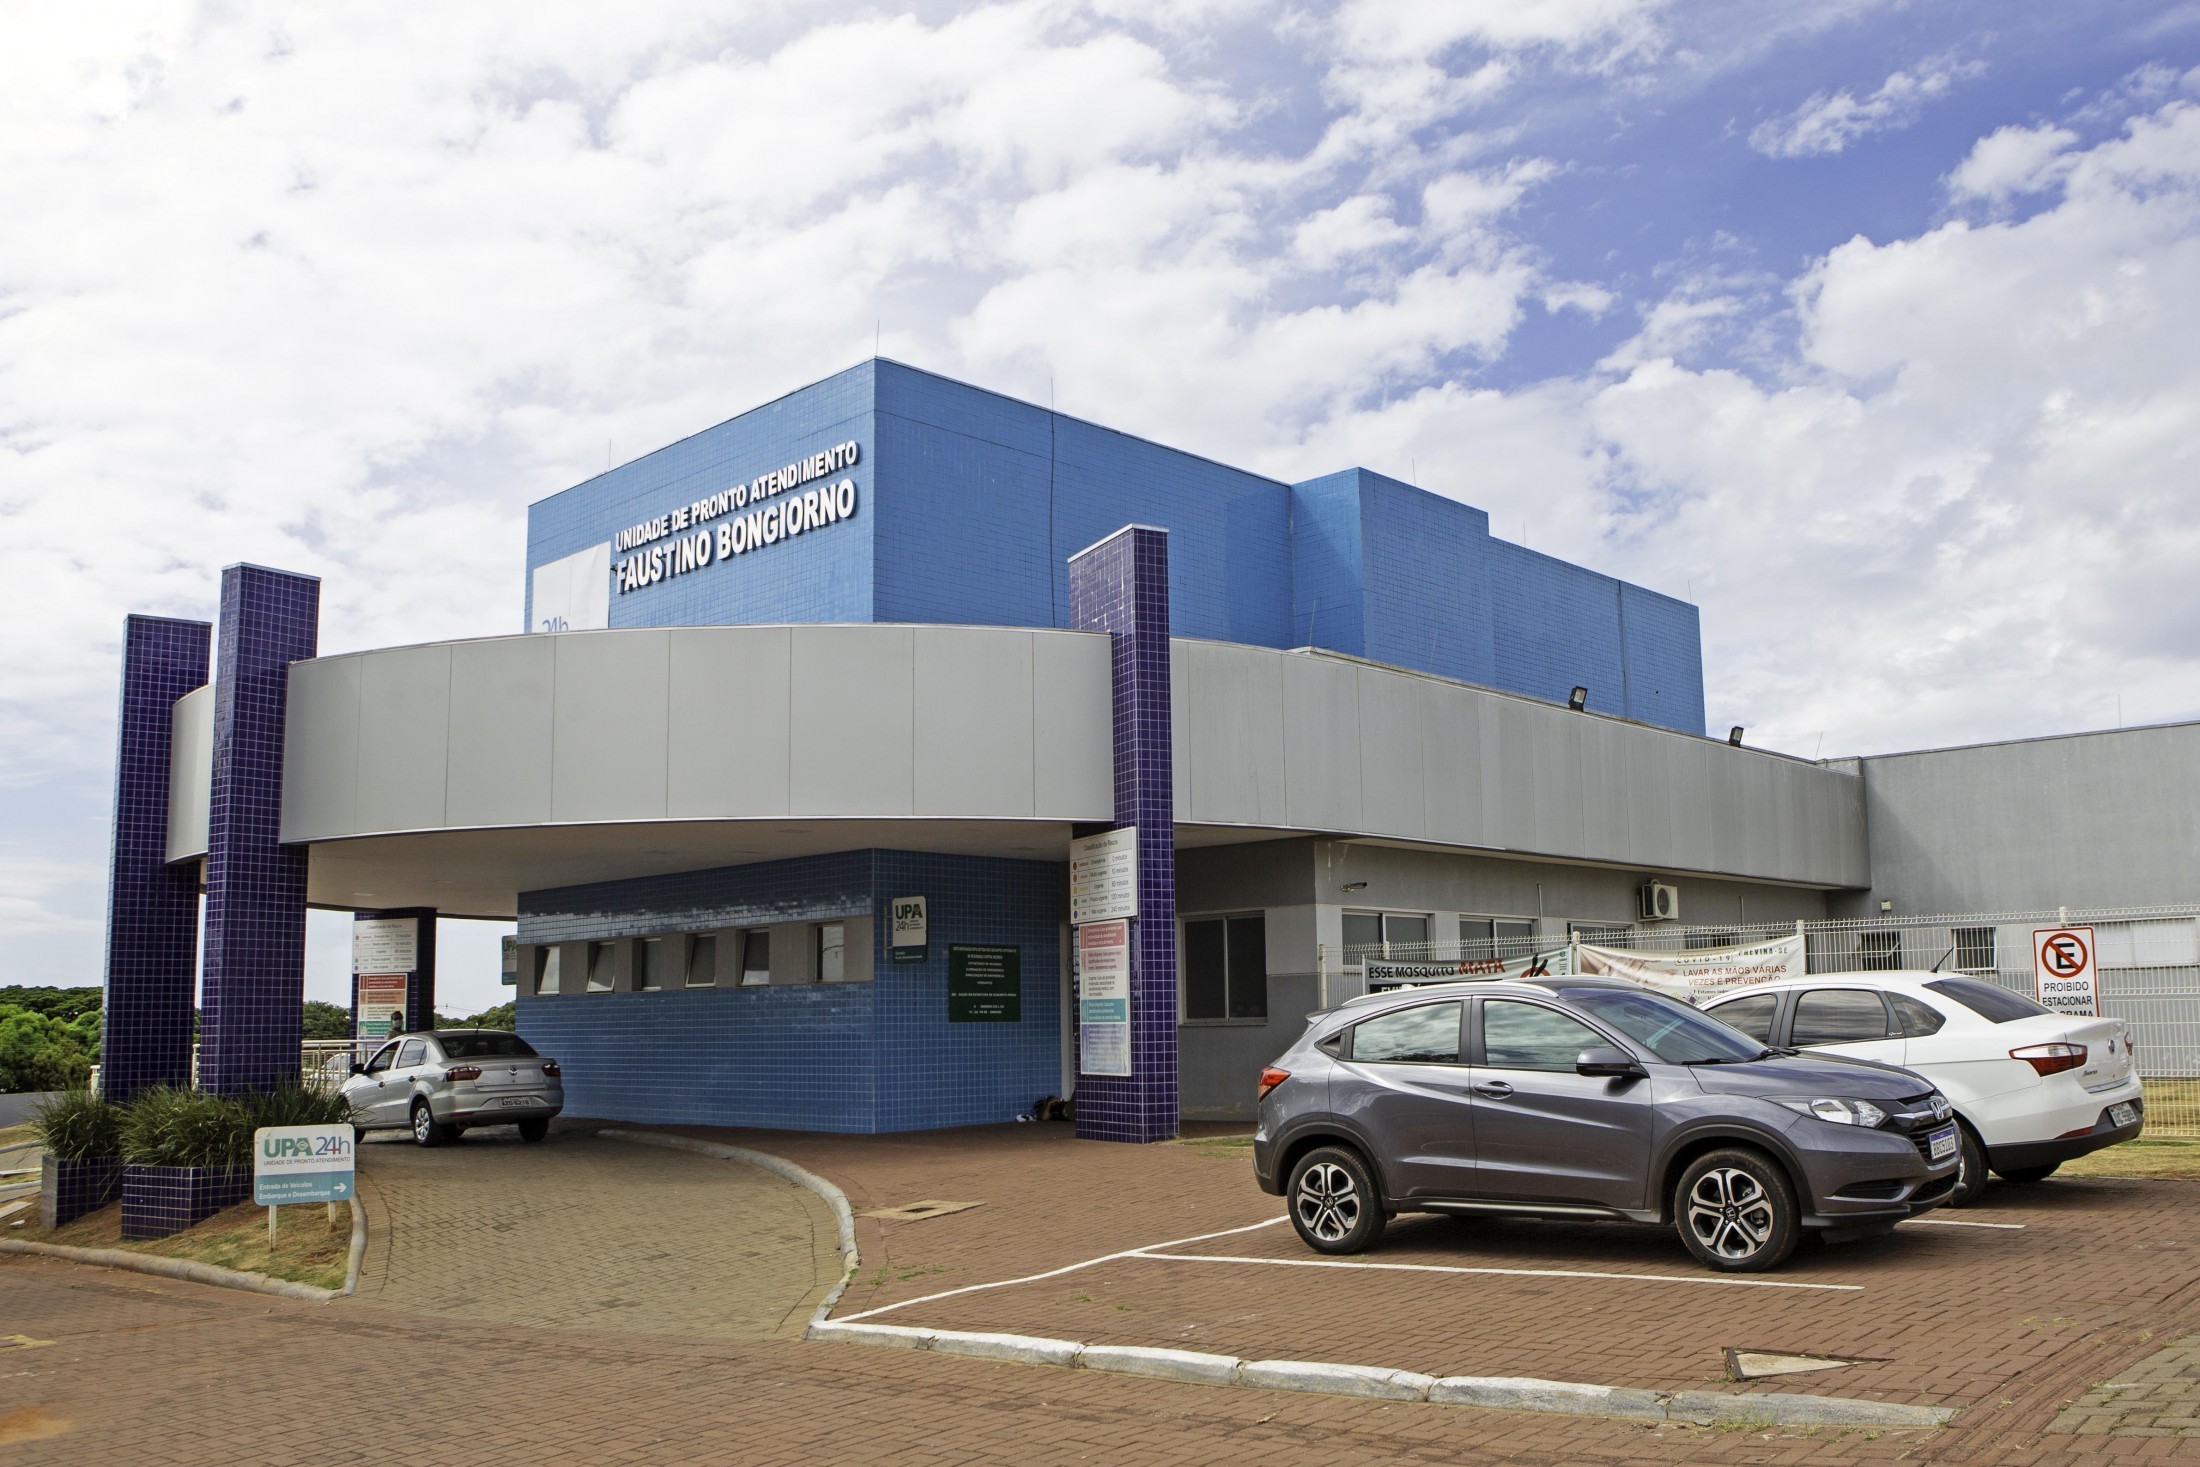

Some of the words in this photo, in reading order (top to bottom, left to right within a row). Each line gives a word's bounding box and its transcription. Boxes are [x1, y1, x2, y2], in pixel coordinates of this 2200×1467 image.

[616, 514, 669, 553] UNIDADE
[672, 506, 690, 532] DE
[691, 484, 747, 525] PRONTO
[749, 440, 858, 503] ATENDIMENTO
[617, 530, 712, 594] FAUSTINO
[717, 478, 856, 560] BONGIORNO
[896, 904, 923, 920] UPA
[1368, 966, 1393, 978] ESSE
[1395, 966, 1454, 978] MOSQUITO
[1458, 958, 1506, 975] MATA
[1683, 968, 1709, 977] LAVAR
[1725, 966, 1750, 974] MÃOS
[1752, 965, 1787, 974] VÁRIAS
[1688, 978, 1715, 986] VEZES
[1717, 976, 1723, 985] É
[2044, 981, 2089, 992] PROIBIDO
[2042, 996, 2092, 1006] ESTACIONAR
[264, 1137, 313, 1158] UPA
[315, 1136, 350, 1156] 24h
